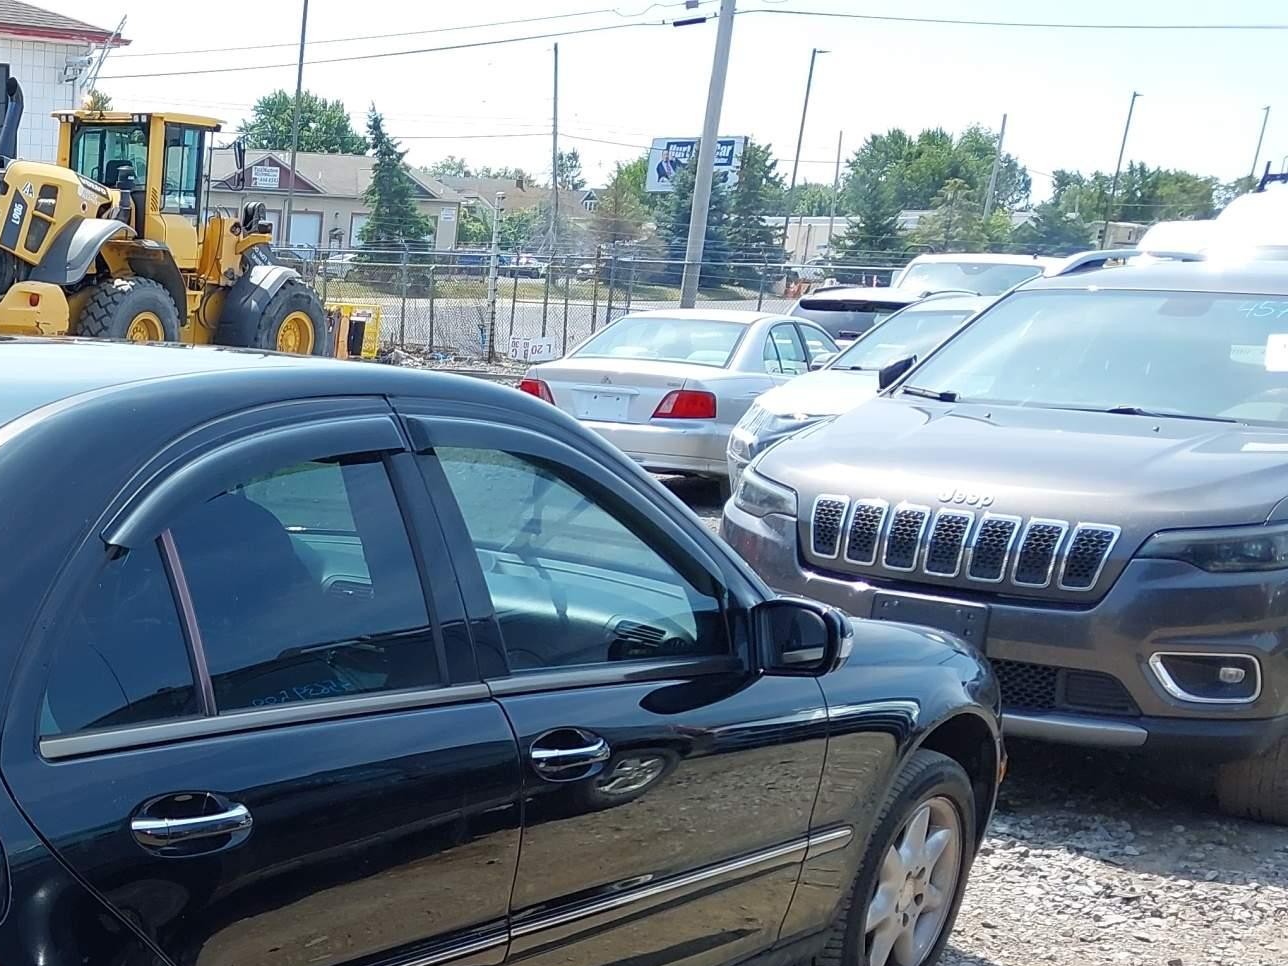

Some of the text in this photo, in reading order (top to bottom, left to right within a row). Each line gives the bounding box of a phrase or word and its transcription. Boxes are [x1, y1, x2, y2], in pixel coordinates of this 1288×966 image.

[669, 144, 691, 158] Hurt
[531, 344, 543, 355] 20
[936, 487, 996, 510] Jeep
